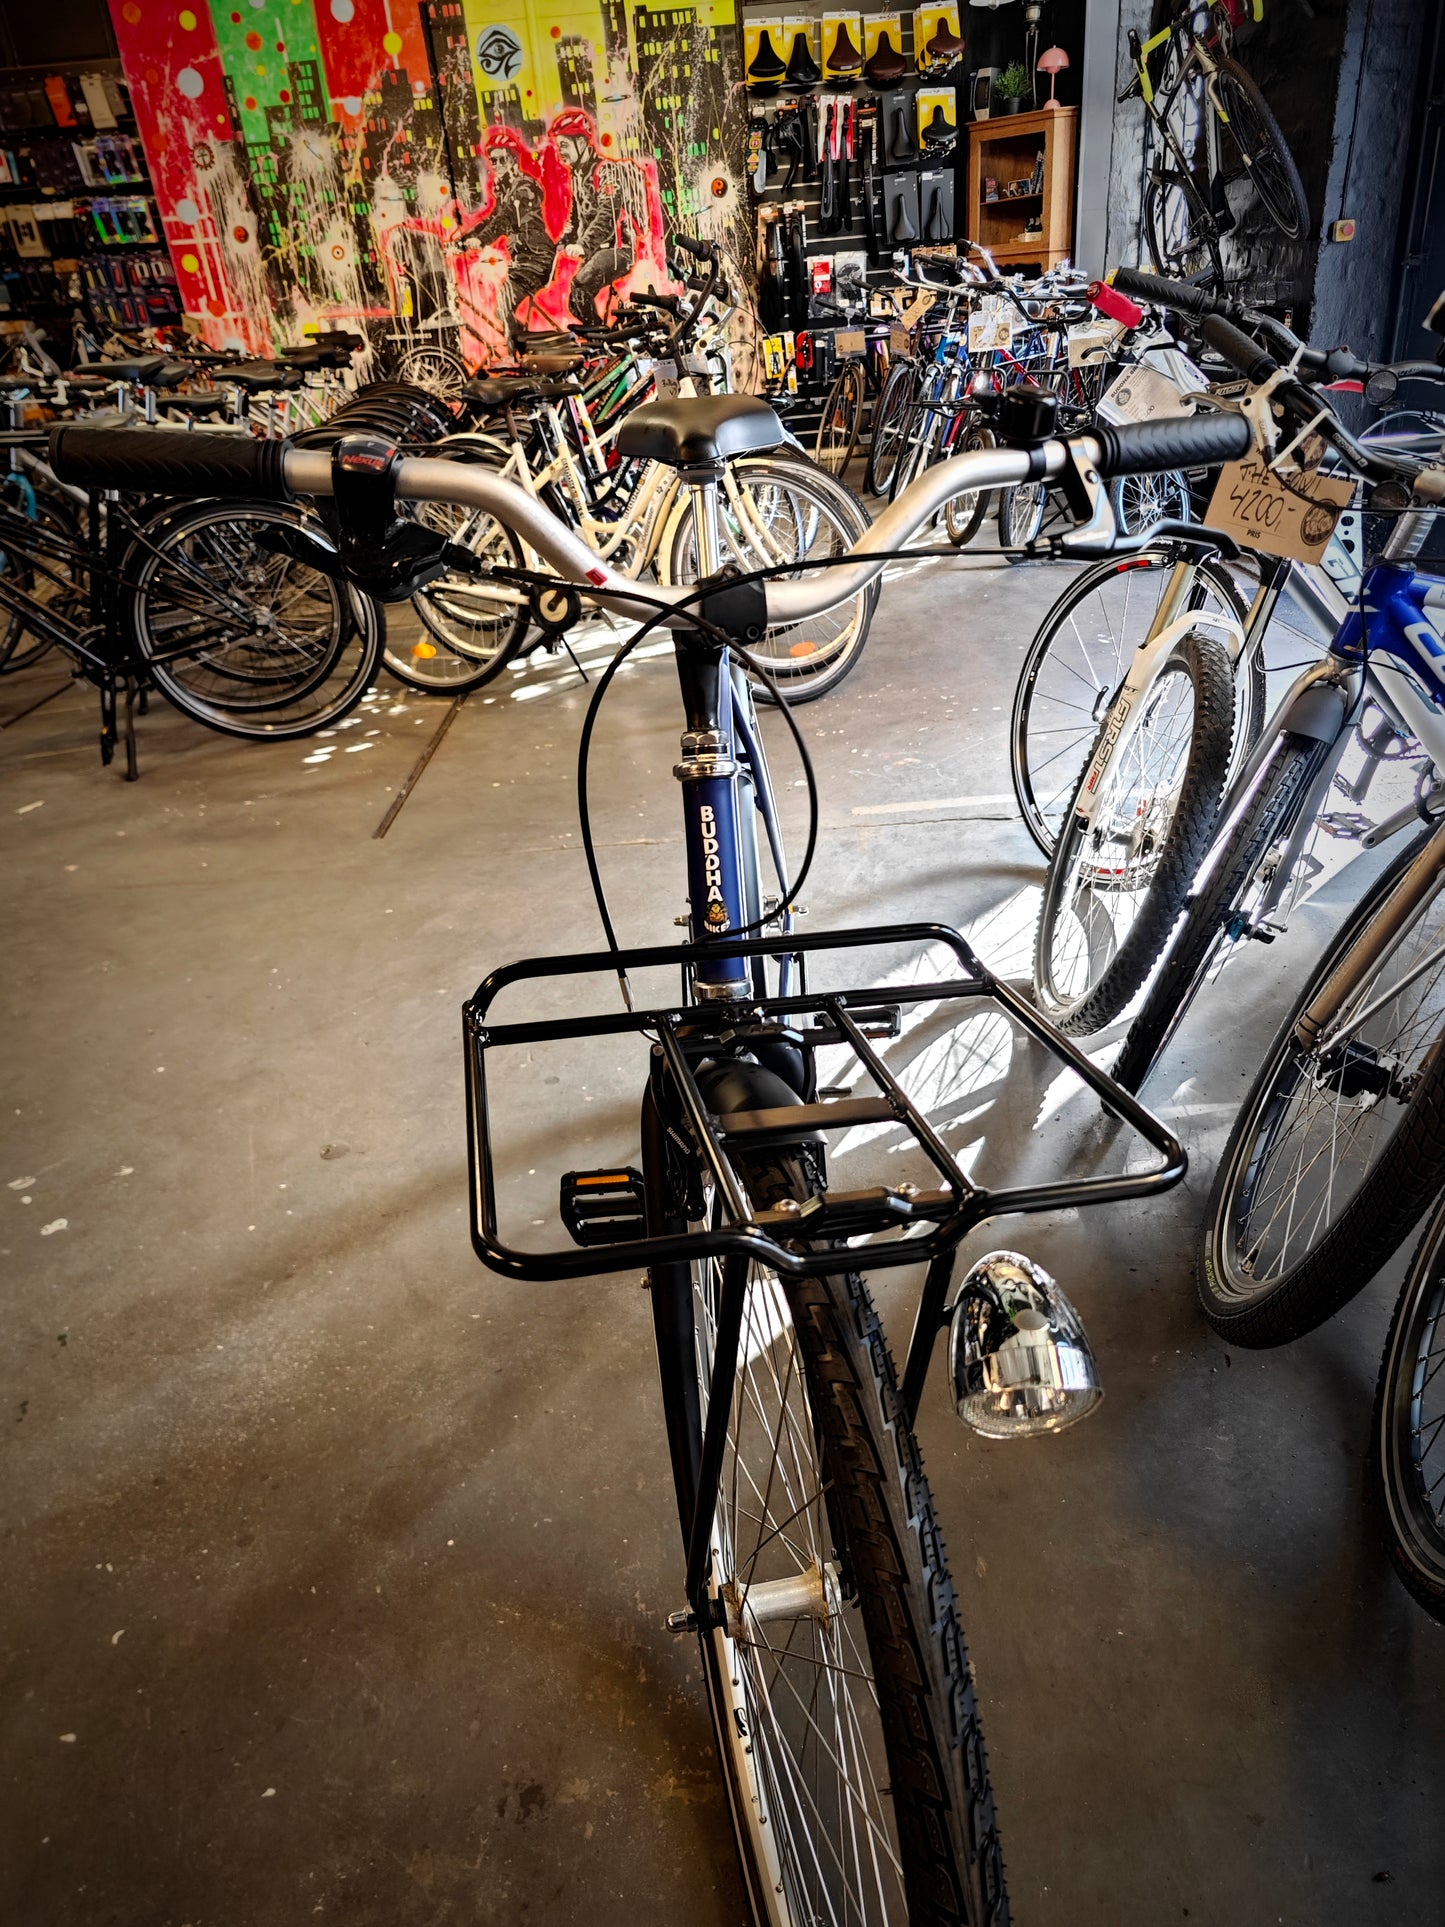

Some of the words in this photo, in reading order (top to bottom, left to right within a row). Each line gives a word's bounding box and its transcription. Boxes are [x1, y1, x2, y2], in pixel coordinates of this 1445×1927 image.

[1110, 375, 1131, 398] BUDDHA
[1246, 529, 1262, 539] PRIS
[1091, 698, 1131, 795] FIRST
[700, 806, 723, 902] BUDDHA
[667, 1126, 691, 1155] SHIMANO
